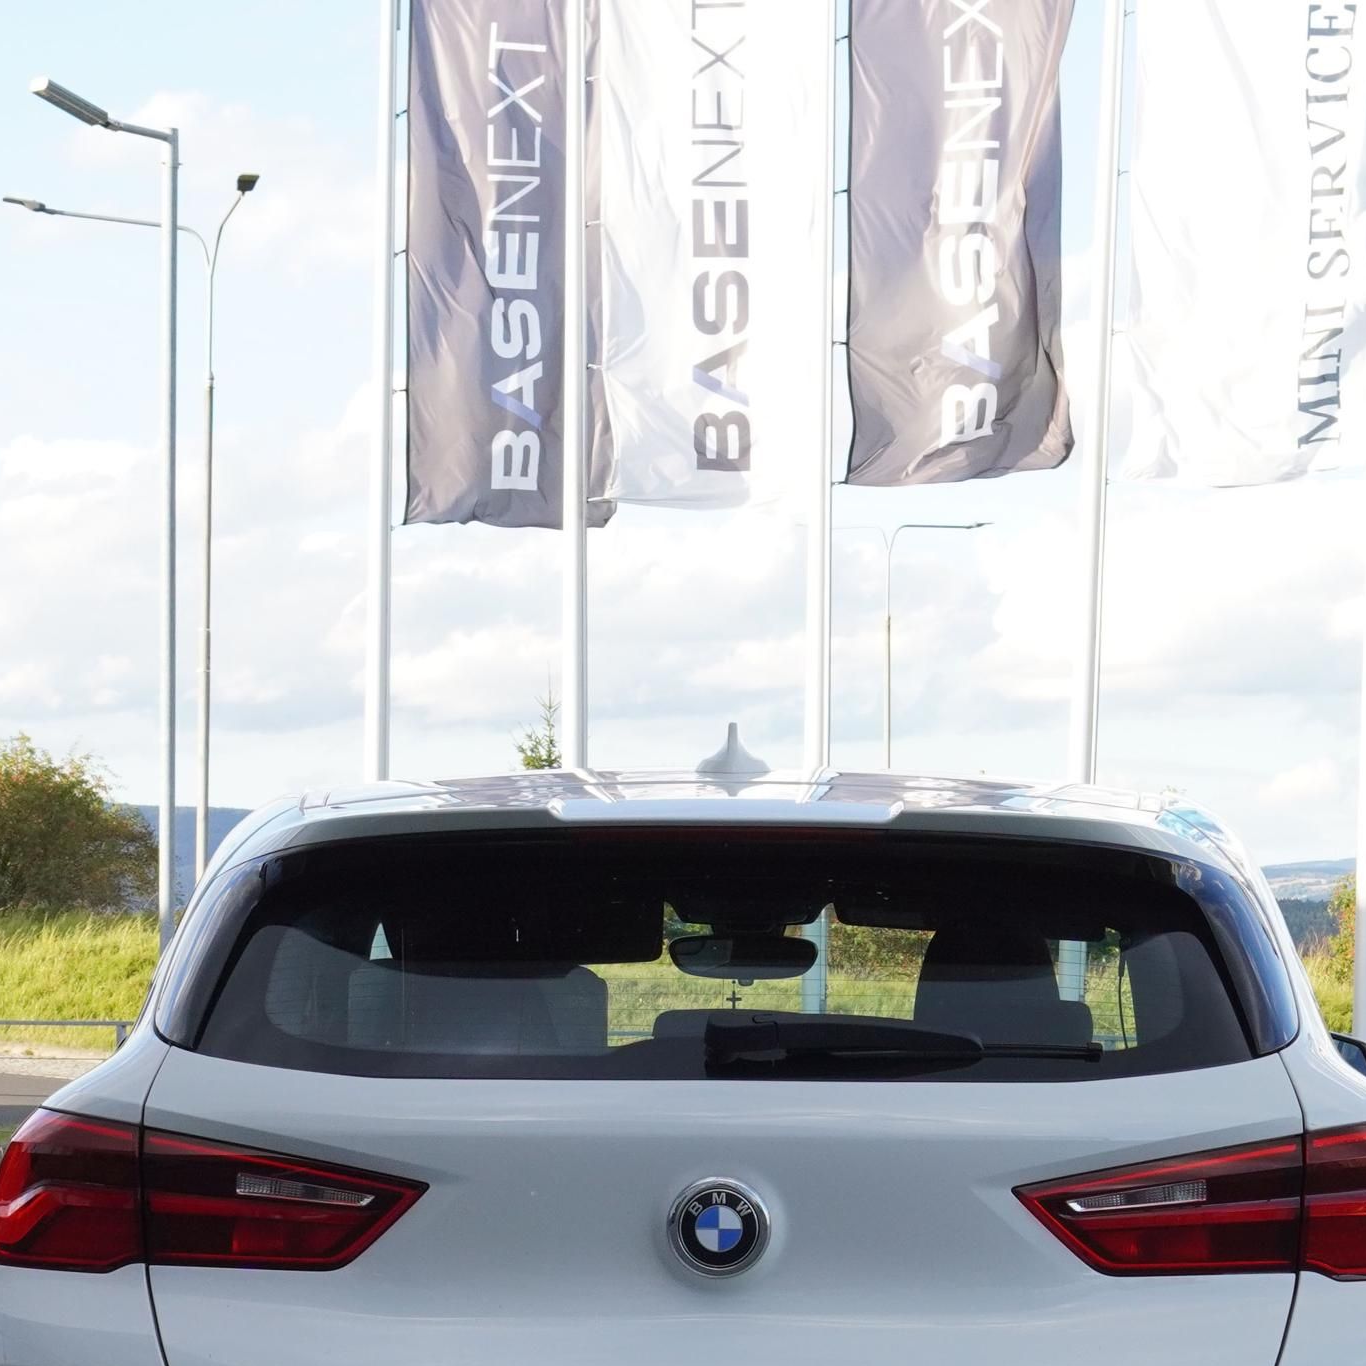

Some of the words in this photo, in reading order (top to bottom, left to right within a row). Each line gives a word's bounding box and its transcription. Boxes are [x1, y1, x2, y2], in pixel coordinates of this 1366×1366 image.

[486, 22, 548, 491] BASENEXT
[691, 0, 751, 472] BASENEXT
[1304, 4, 1358, 281] SERVICE
[1297, 301, 1346, 449] MINI
[688, 1192, 752, 1216] BMW
